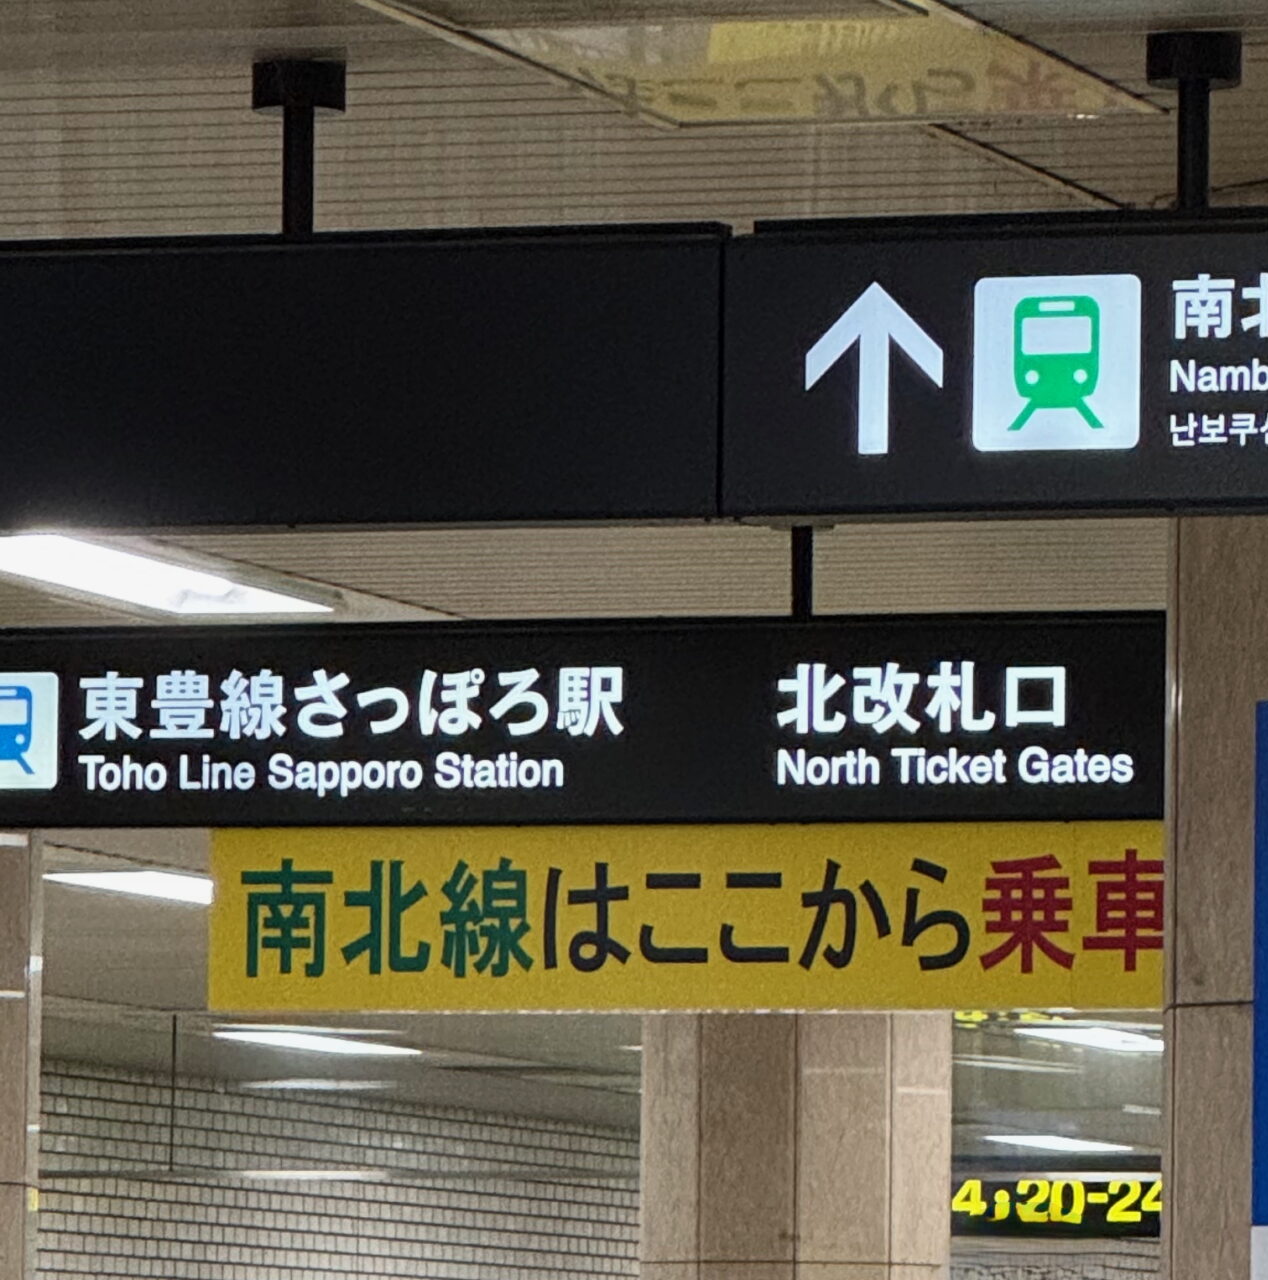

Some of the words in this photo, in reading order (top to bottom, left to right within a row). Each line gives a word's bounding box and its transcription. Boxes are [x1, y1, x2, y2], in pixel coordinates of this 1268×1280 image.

[78, 666, 624, 741] 東豊線さっぽろ駅
[776, 660, 1066, 734] 北改札口
[77, 754, 168, 791] Toho
[179, 754, 256, 790] Line
[267, 752, 423, 797] Sapporo
[434, 751, 564, 789] Station
[777, 747, 881, 786] North
[890, 747, 1007, 785] Ticket
[1017, 745, 1134, 784] Gates
[240, 850, 1164, 979] 南北線はここから乗車
